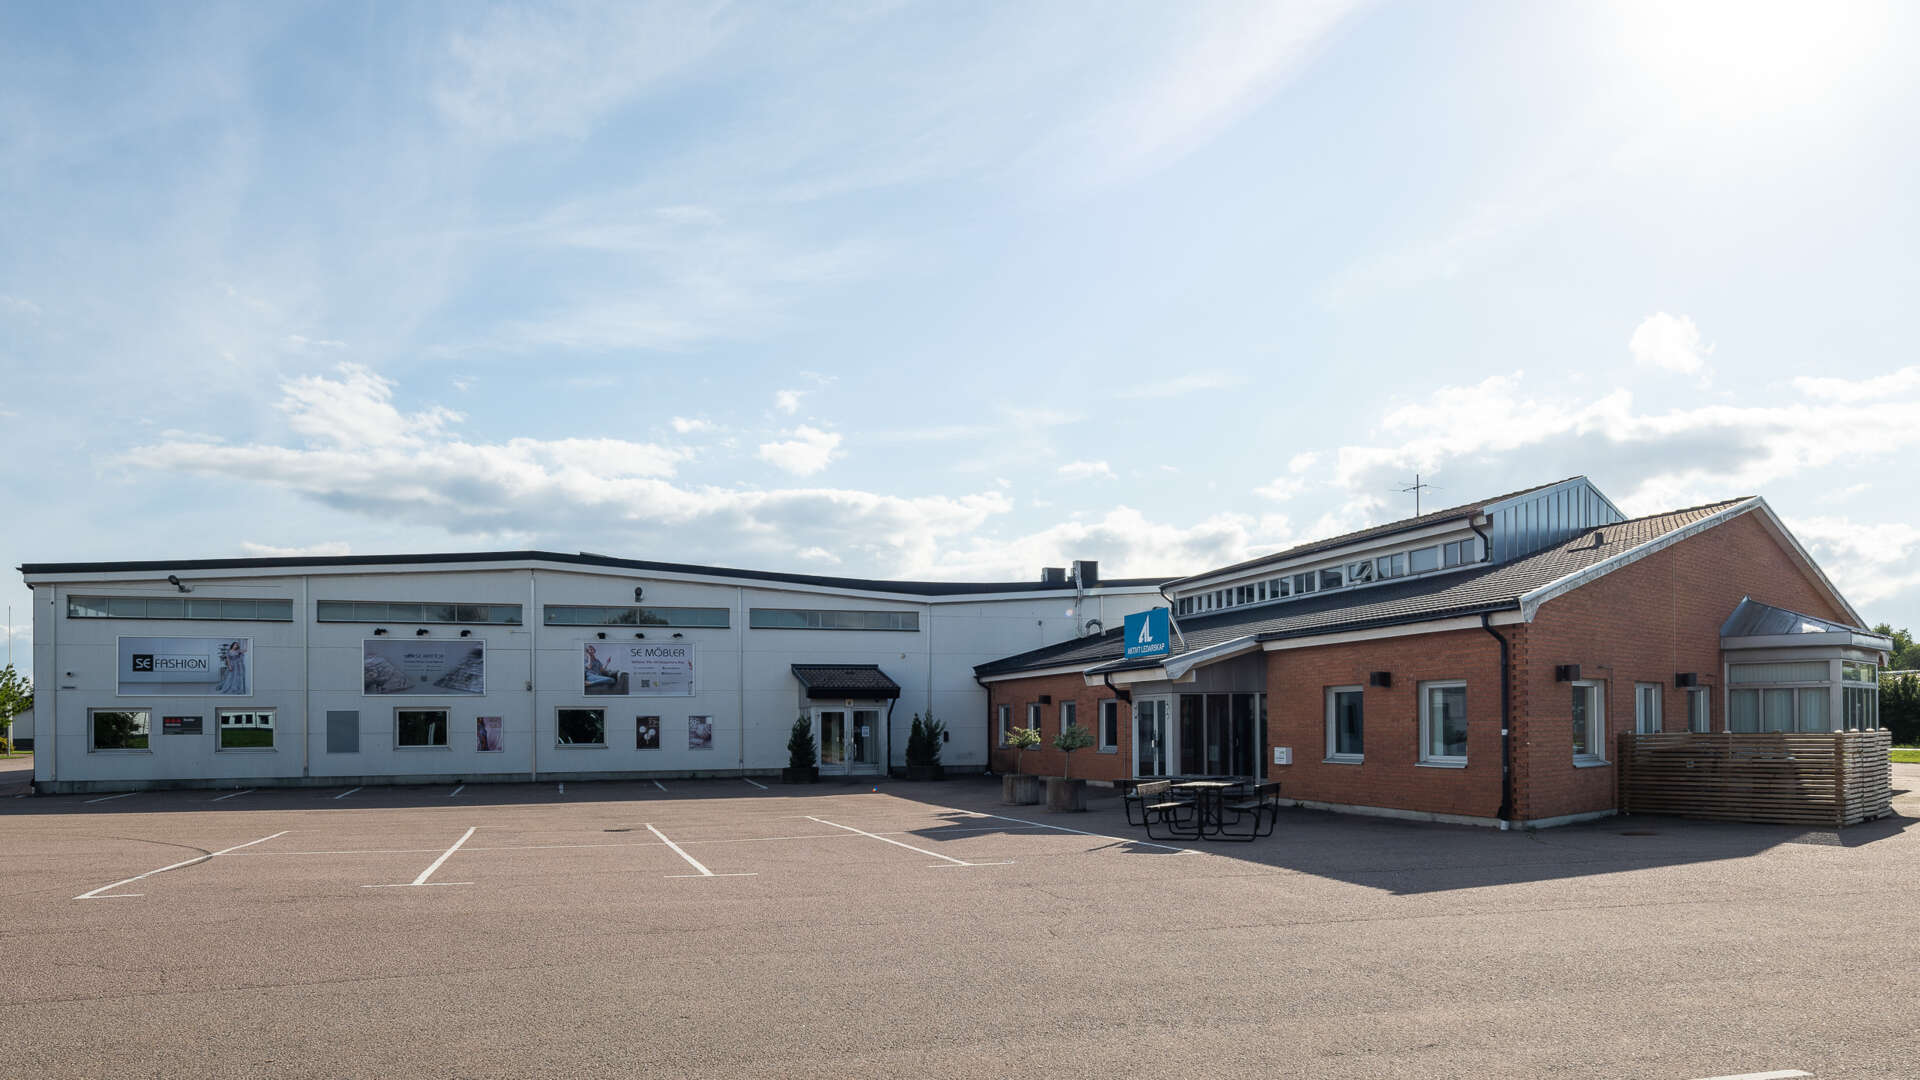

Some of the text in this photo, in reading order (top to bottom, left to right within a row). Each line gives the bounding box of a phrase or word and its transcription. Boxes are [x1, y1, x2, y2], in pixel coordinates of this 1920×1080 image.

[630, 647, 685, 657] SE MÖBLER
[1127, 642, 1165, 655] AKTIVT LEDARSKAP
[135, 658, 207, 669] SE FASHION
